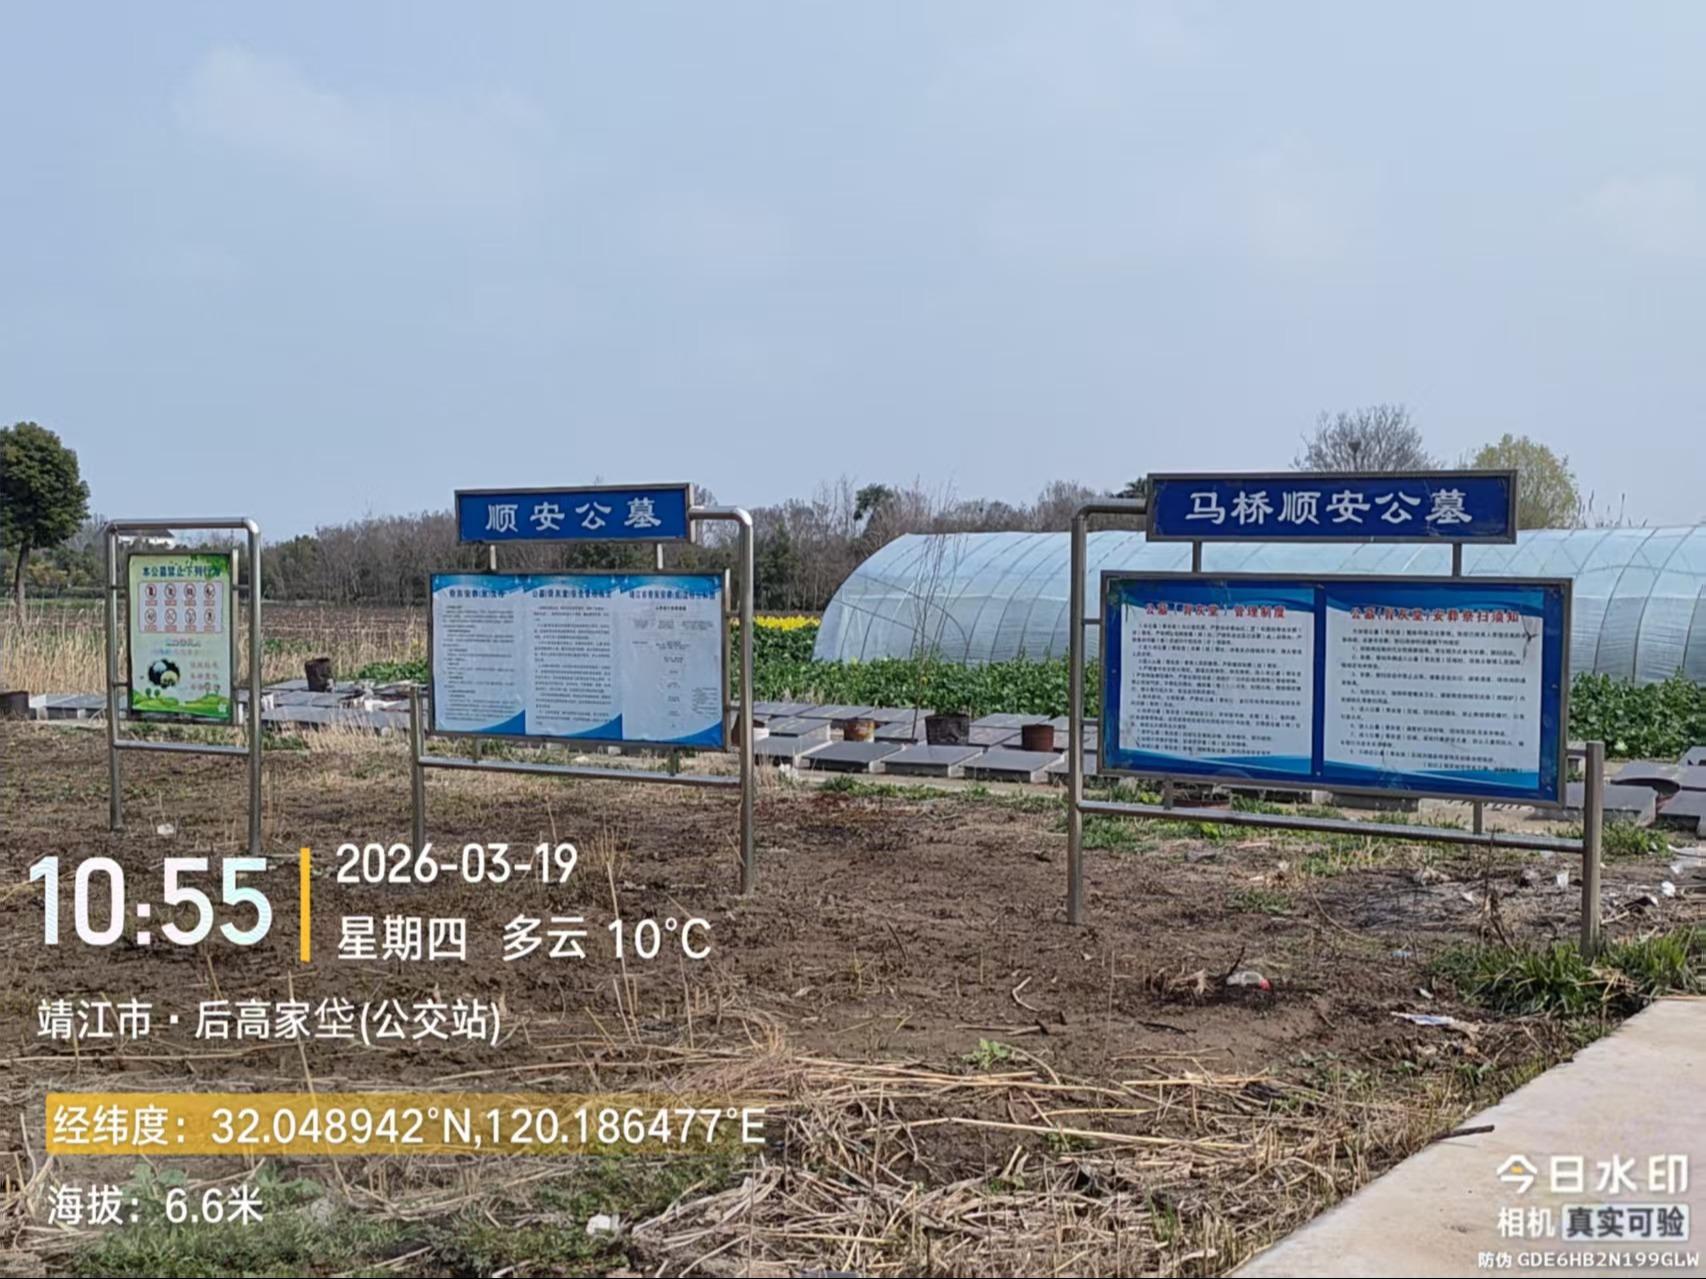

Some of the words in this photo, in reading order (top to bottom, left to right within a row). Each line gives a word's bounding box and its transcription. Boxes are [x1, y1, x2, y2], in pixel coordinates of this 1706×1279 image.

[485, 496, 662, 534] 顺安公墓
[1185, 487, 1473, 526] 马桥顺安公墓
